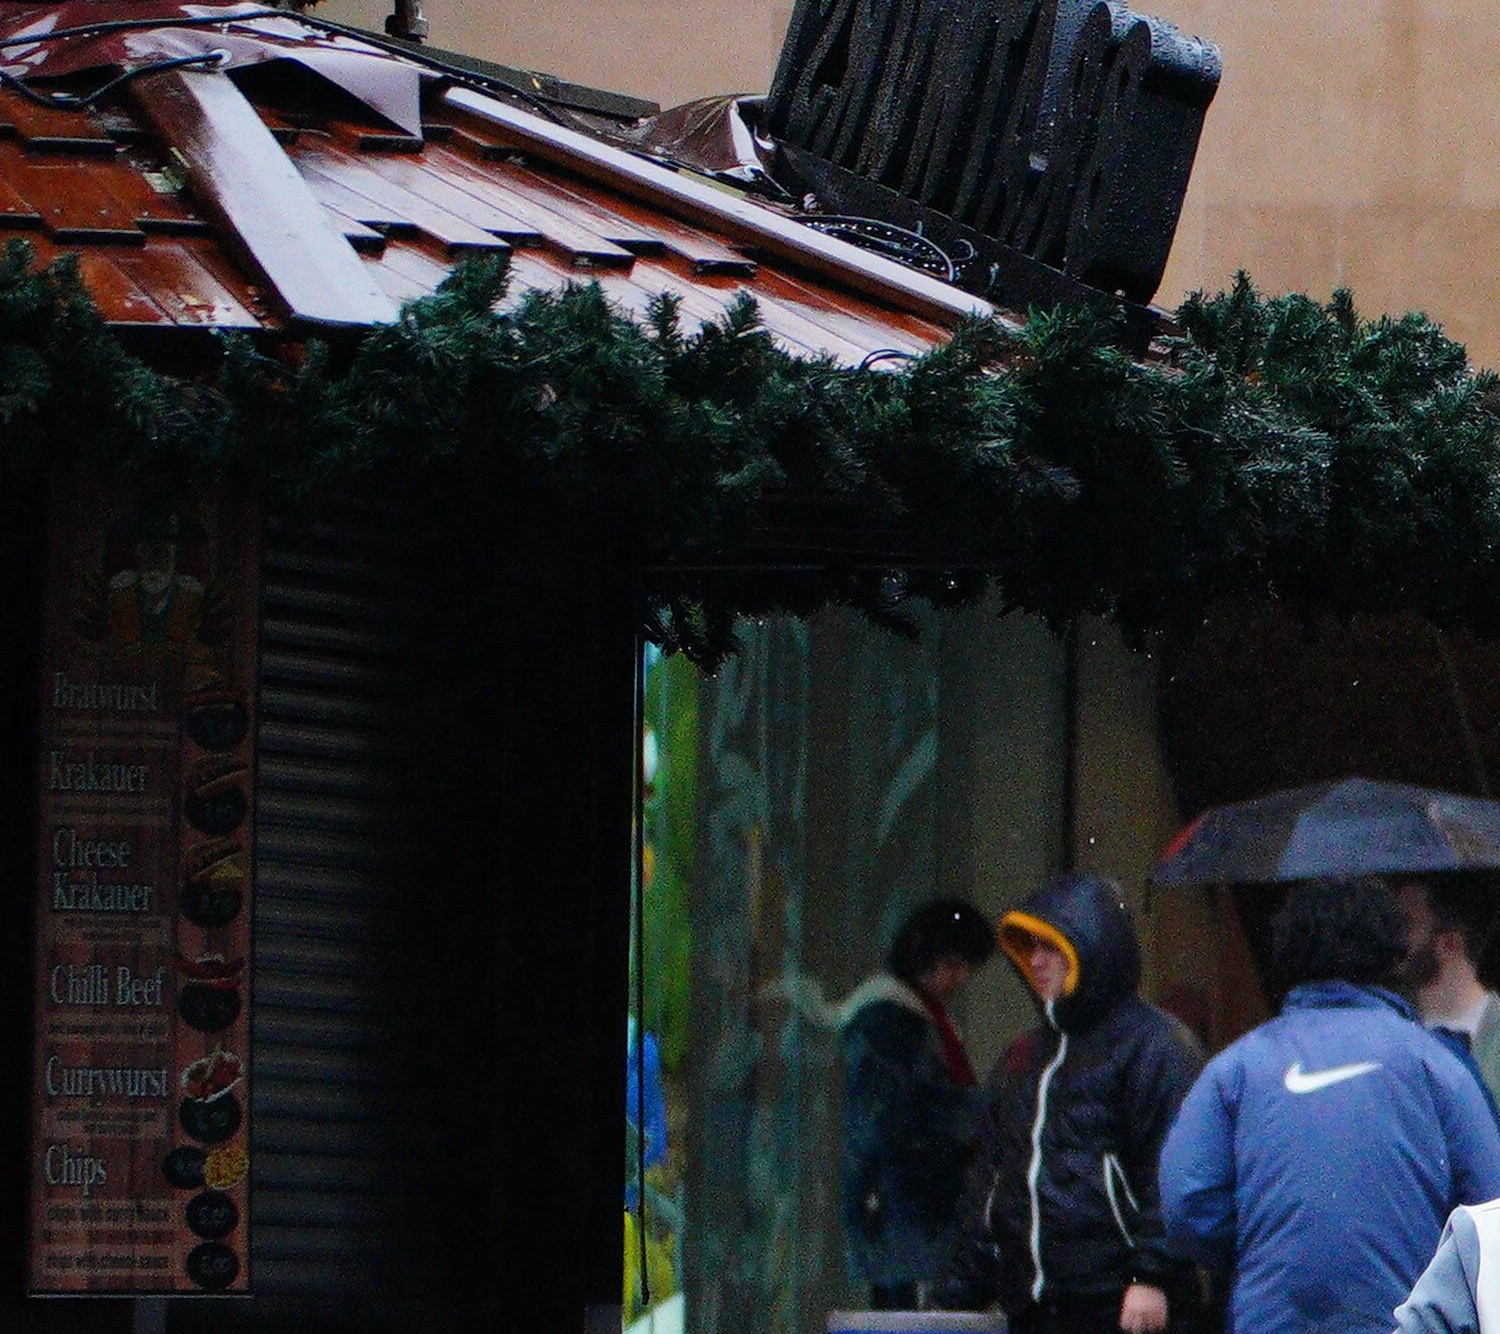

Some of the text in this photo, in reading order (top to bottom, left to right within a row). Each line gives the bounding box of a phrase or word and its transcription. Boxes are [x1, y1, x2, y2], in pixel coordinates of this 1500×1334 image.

[52, 671, 158, 711] Bratwurst
[49, 750, 149, 793] Krakauer
[53, 827, 131, 868] Cheese
[52, 869, 154, 912] Krakauer
[50, 963, 109, 1007] Chilli
[115, 966, 165, 1007] Beef
[45, 1055, 169, 1106] Currywurst
[45, 1143, 108, 1196] Chips
